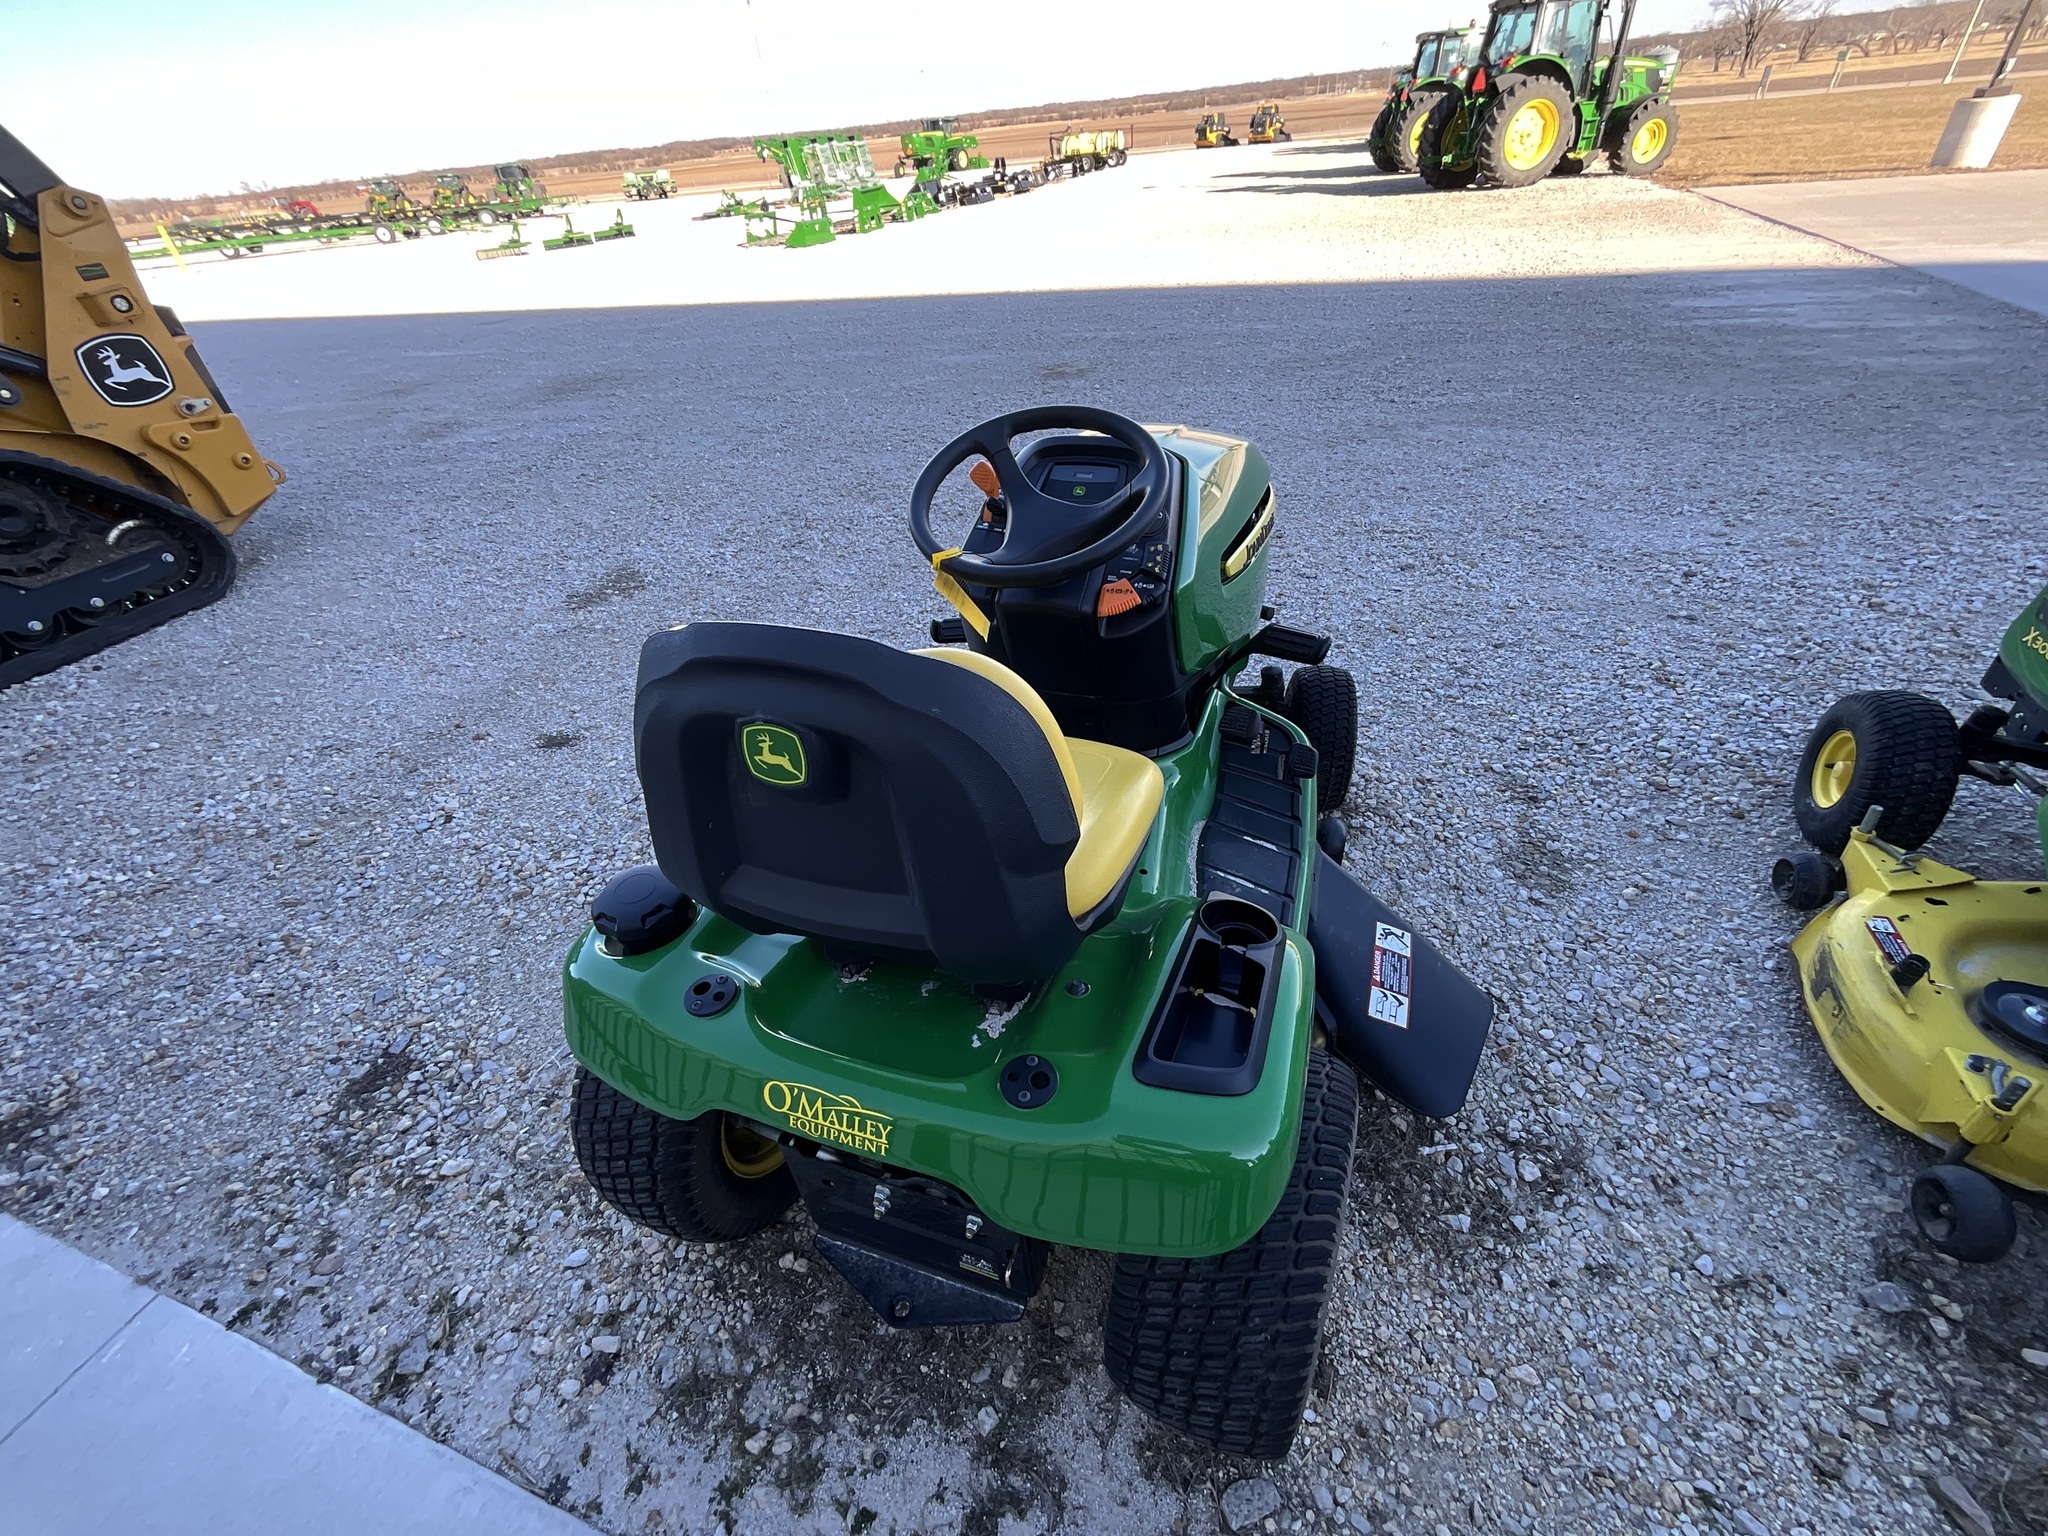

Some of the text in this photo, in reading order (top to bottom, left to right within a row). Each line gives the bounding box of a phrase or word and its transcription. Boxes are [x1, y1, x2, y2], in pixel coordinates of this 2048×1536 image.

[2022, 626, 2048, 661] X30
[1373, 950, 1382, 973] DANGER
[763, 1080, 893, 1144] O'MALLEY
[789, 1114, 889, 1157] EQUIPMENT
